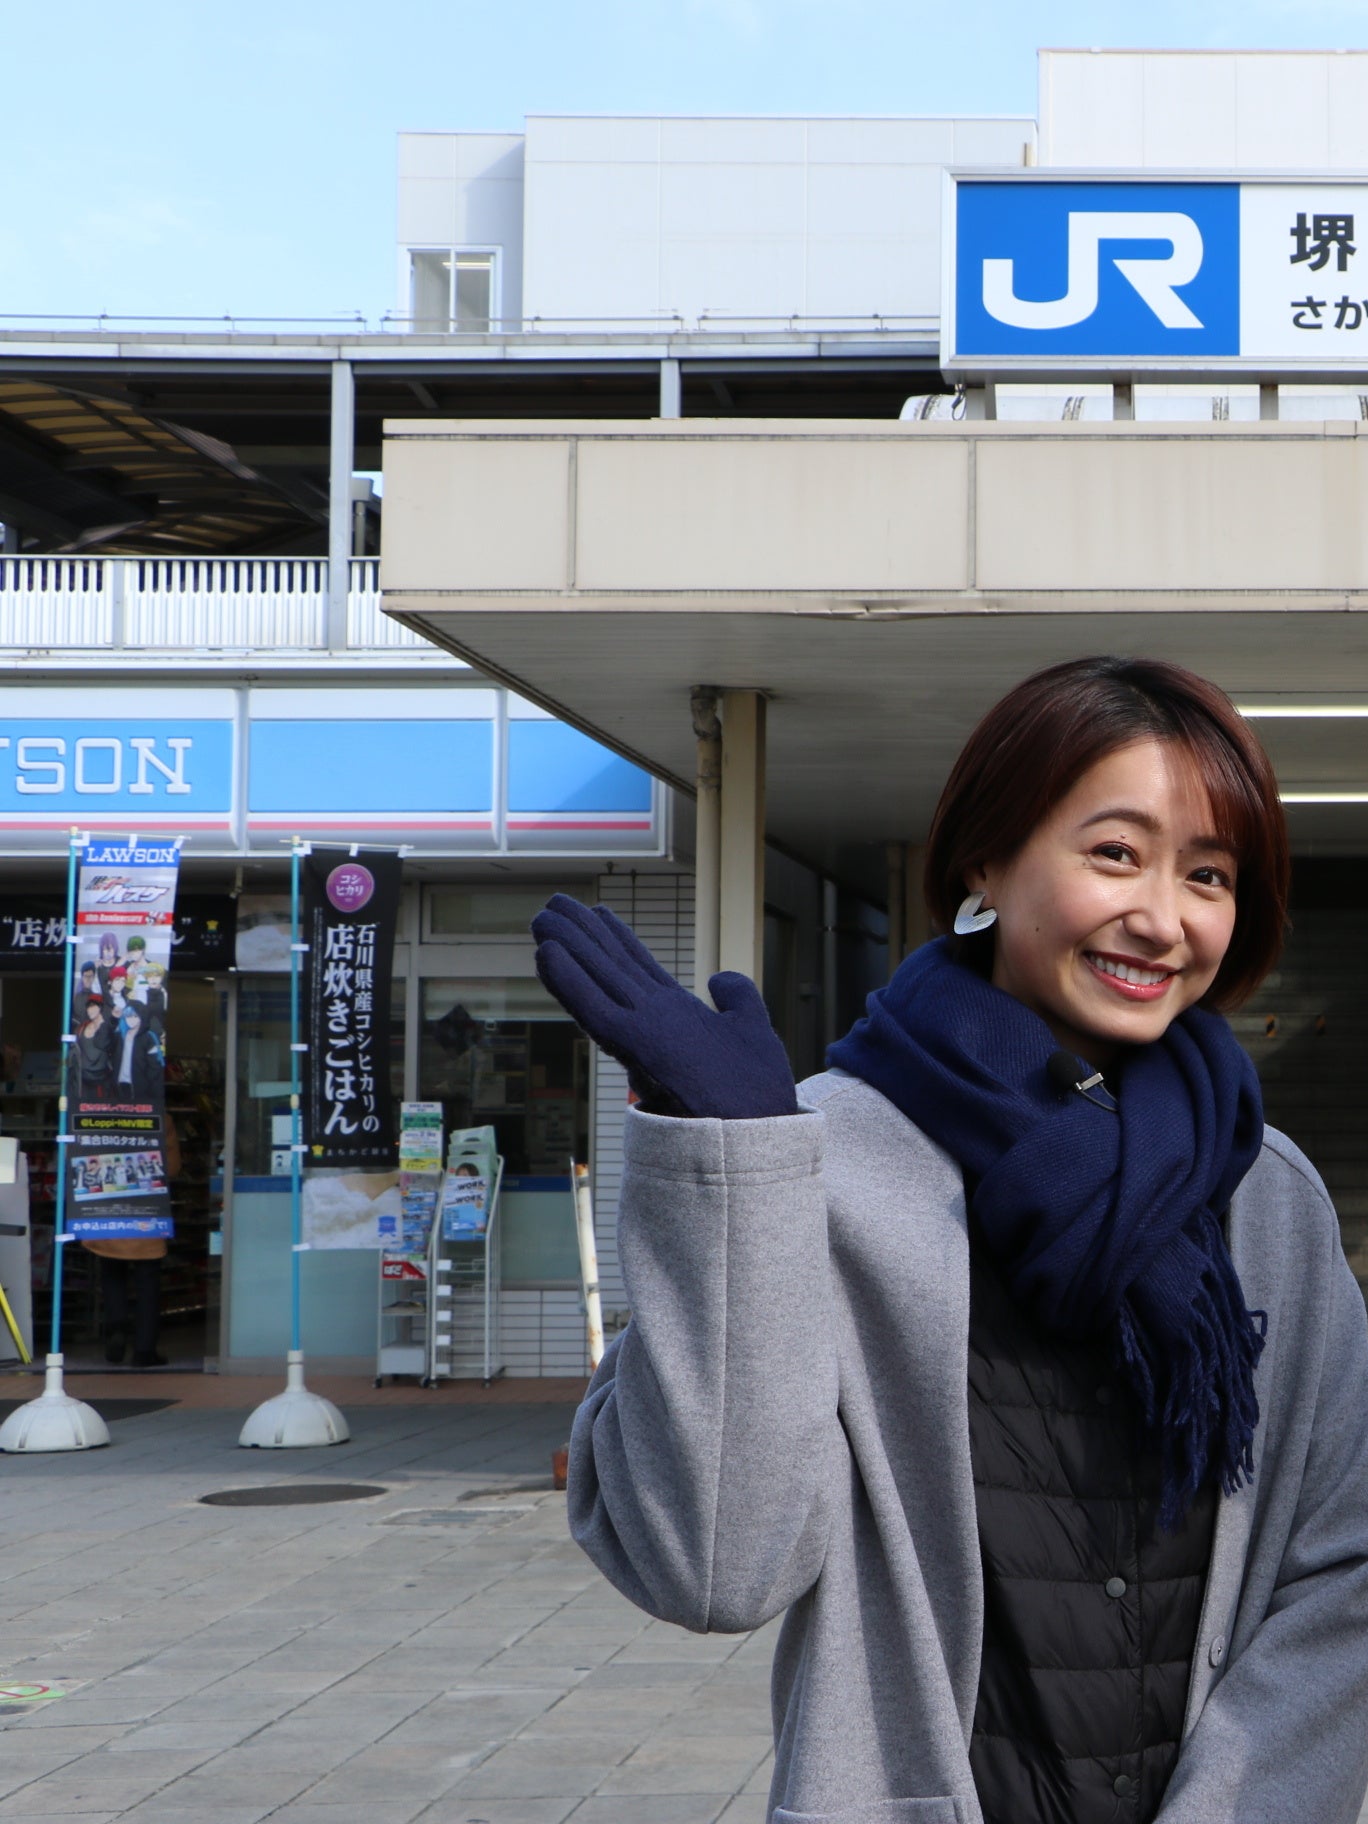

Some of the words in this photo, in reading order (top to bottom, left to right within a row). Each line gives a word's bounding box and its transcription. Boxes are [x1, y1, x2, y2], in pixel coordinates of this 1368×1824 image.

[982, 211, 1205, 329] JR
[0, 737, 193, 795] SON
[86, 847, 176, 864] LAWSON
[340, 874, 363, 884] コシ
[336, 885, 364, 896] ヒカリ
[322, 923, 359, 1136] 店炊きごはん
[354, 923, 380, 1133] 石川県産コシヒカリの
